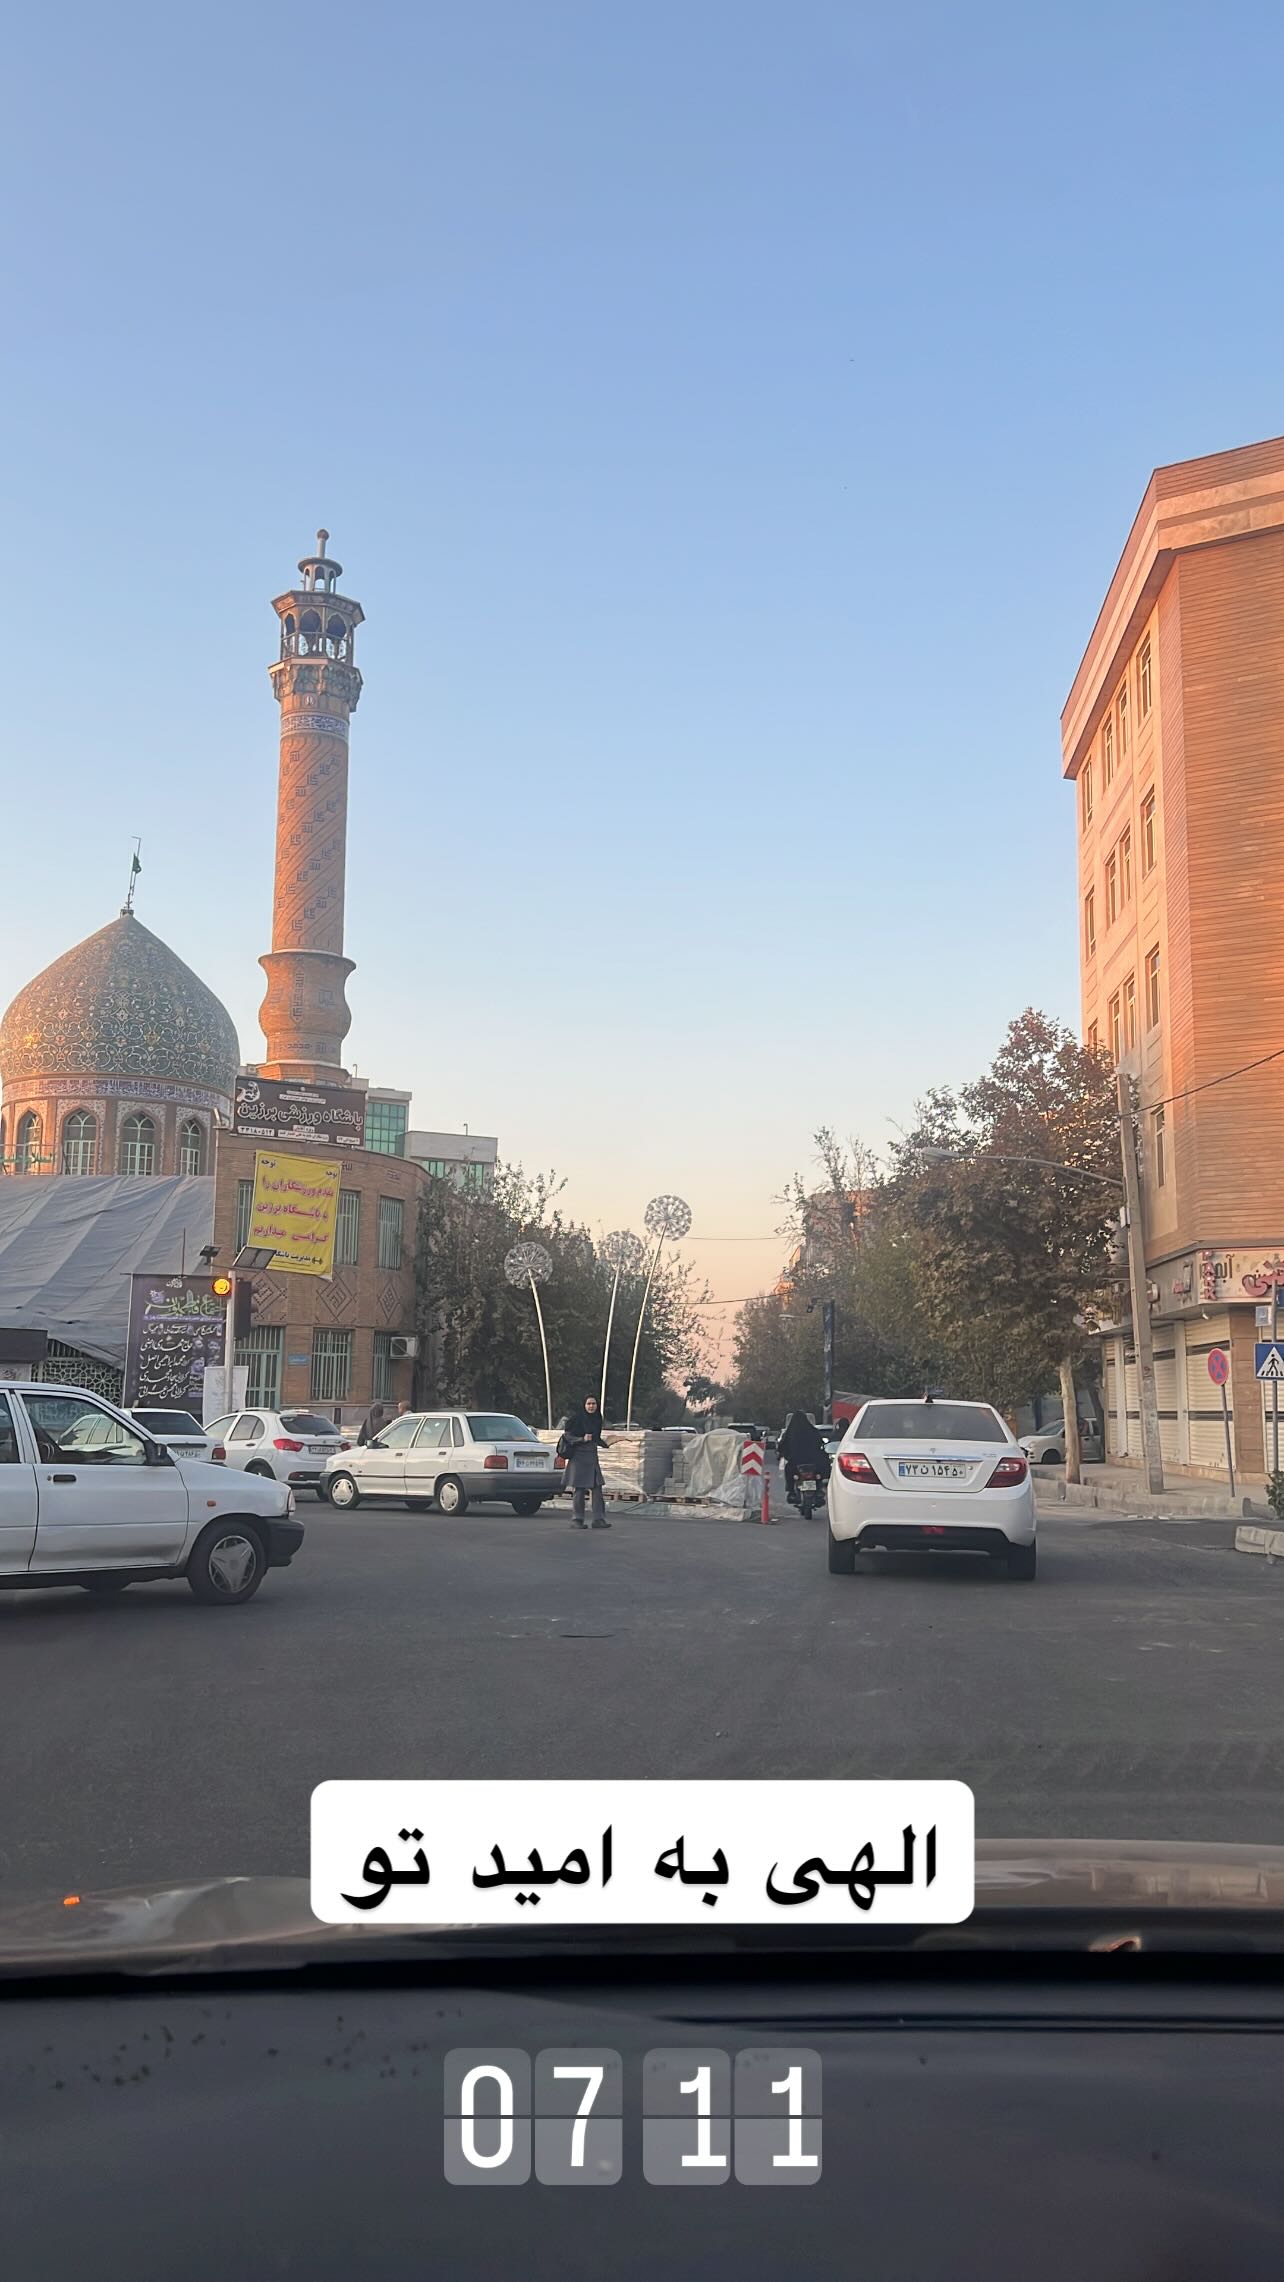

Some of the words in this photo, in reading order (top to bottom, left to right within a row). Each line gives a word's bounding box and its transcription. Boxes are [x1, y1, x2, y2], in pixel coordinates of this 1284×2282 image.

[237, 1102, 278, 1121] برزین
[278, 1104, 323, 1125] ورزشی
[323, 1109, 363, 1131] باشگاه
